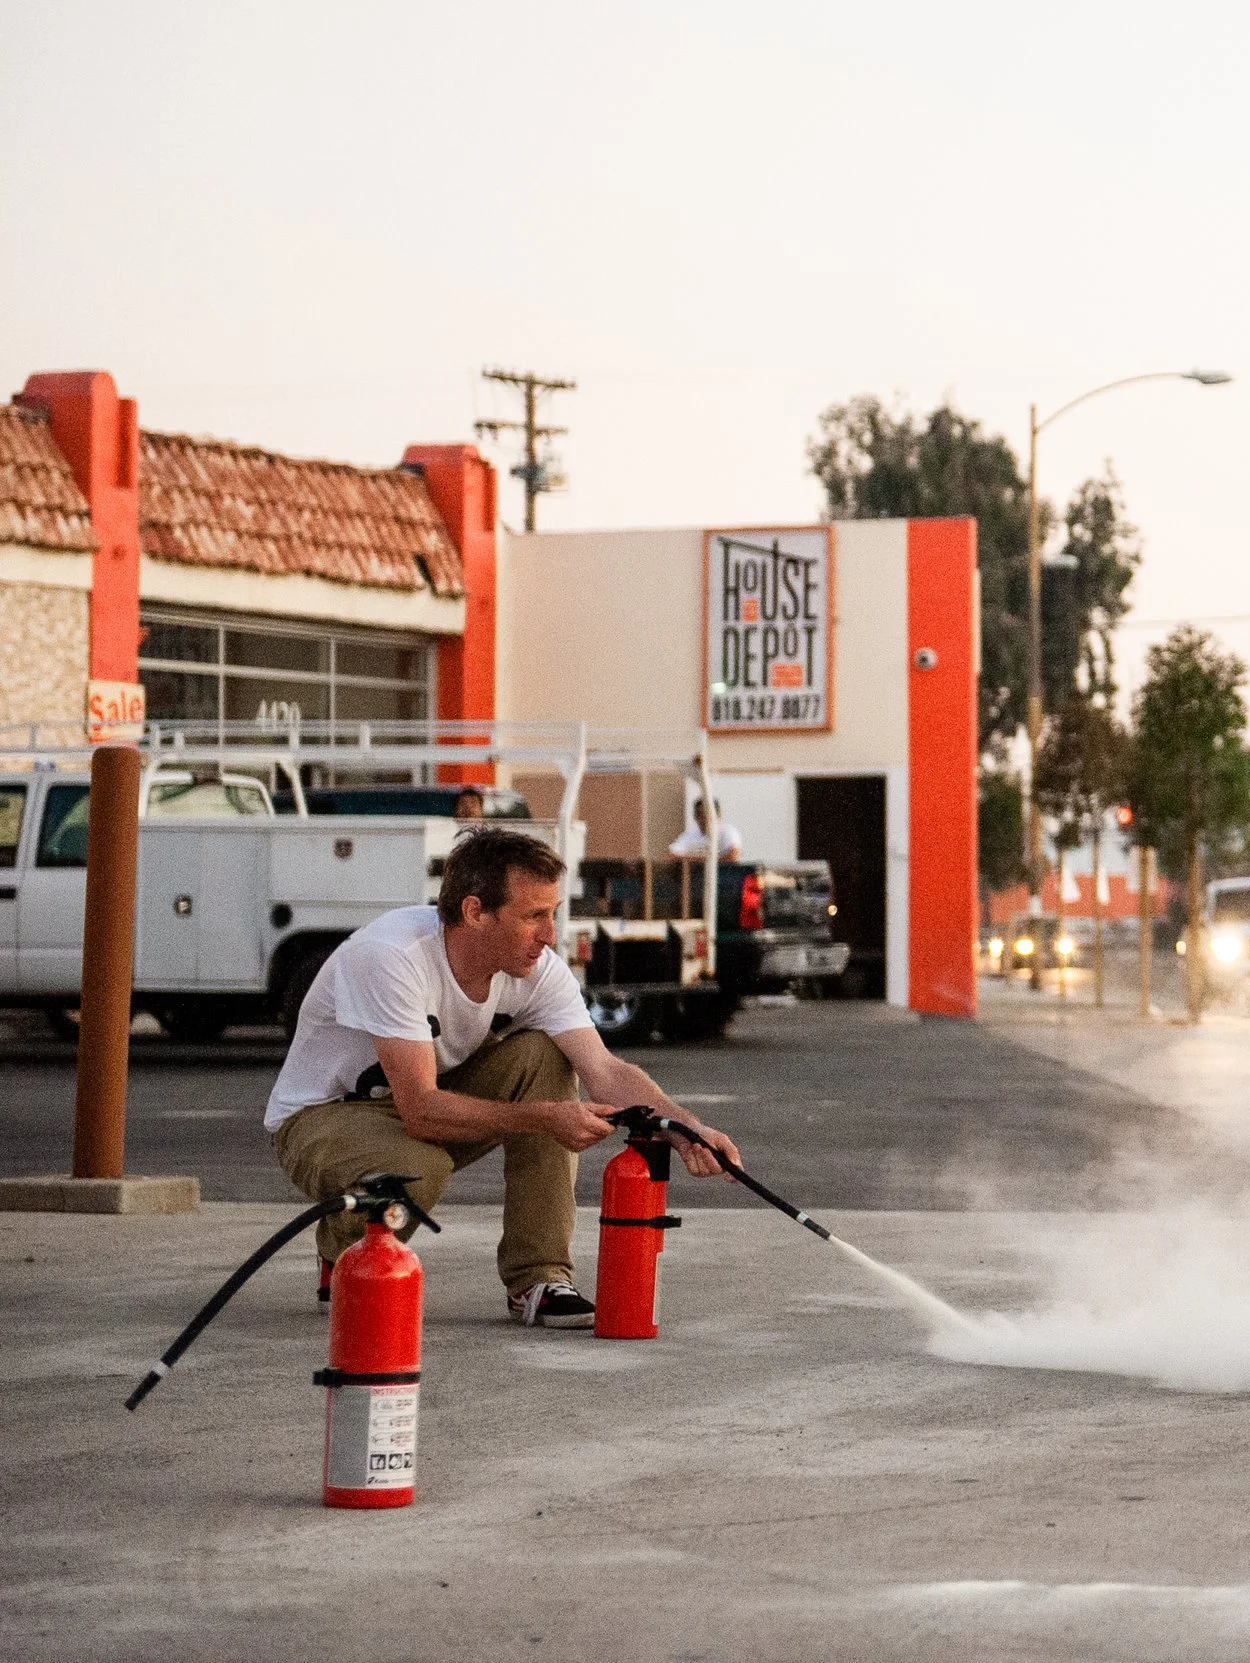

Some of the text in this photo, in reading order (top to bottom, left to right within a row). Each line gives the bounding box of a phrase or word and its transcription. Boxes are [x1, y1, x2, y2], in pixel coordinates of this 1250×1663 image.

[719, 536, 818, 622] HOUSE
[722, 622, 817, 688] DEPOT
[89, 689, 144, 723] Sale
